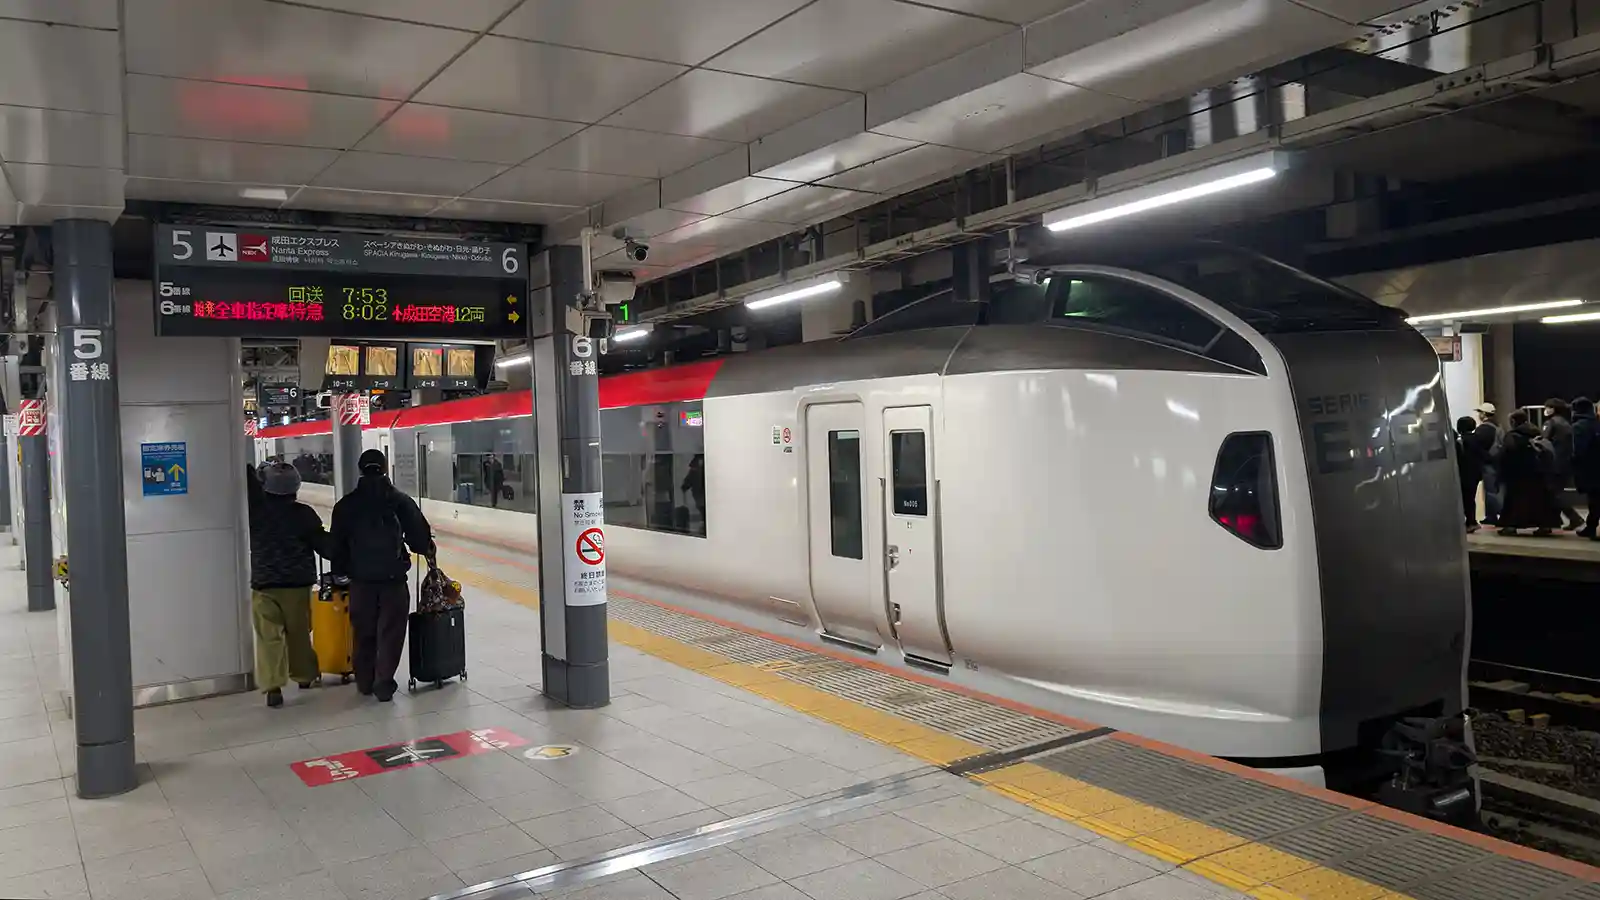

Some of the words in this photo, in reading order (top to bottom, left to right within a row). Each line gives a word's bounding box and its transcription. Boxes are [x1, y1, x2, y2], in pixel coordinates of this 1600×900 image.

[172, 230, 193, 260] 5
[271, 236, 340, 248] 成田エクスプレス
[271, 246, 296, 255] Narita
[298, 248, 329, 257] Express
[502, 248, 519, 274] 6
[288, 286, 324, 303] 回送
[342, 288, 388, 304] 7:53
[342, 304, 388, 321] 8:02
[619, 303, 629, 321] 1
[73, 329, 102, 359] 5
[572, 334, 592, 357] 6
[69, 362, 111, 381] 番線
[569, 360, 597, 376] 番線
[289, 387, 297, 397] 6
[1308, 392, 1372, 415] SERIE
